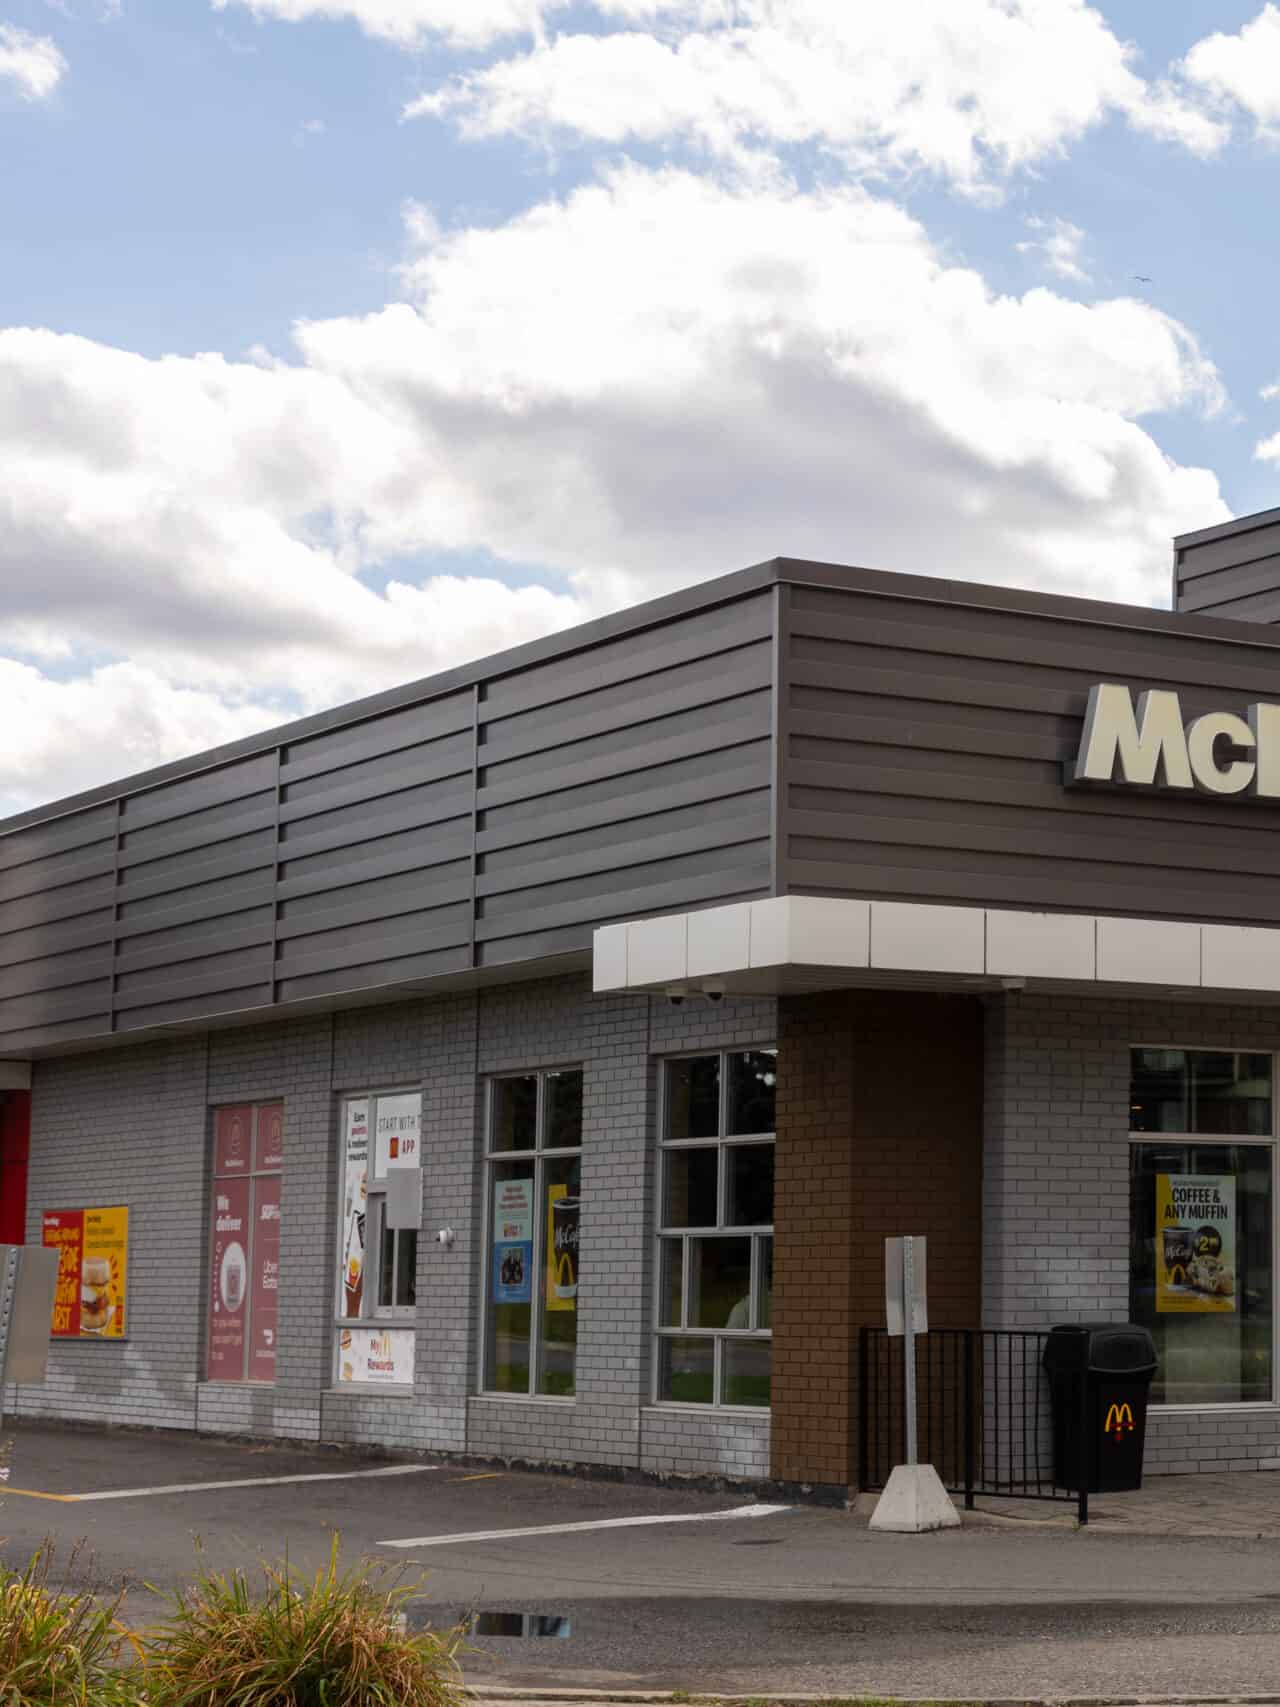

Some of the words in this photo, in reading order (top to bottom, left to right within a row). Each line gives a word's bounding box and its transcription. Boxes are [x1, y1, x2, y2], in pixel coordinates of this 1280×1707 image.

[402, 1138, 415, 1153] APP
[1172, 1187, 1211, 1203] COFFEE
[1212, 1189, 1221, 1203] &
[1164, 1204, 1187, 1220] ANY
[1188, 1204, 1229, 1220] MUFFIN
